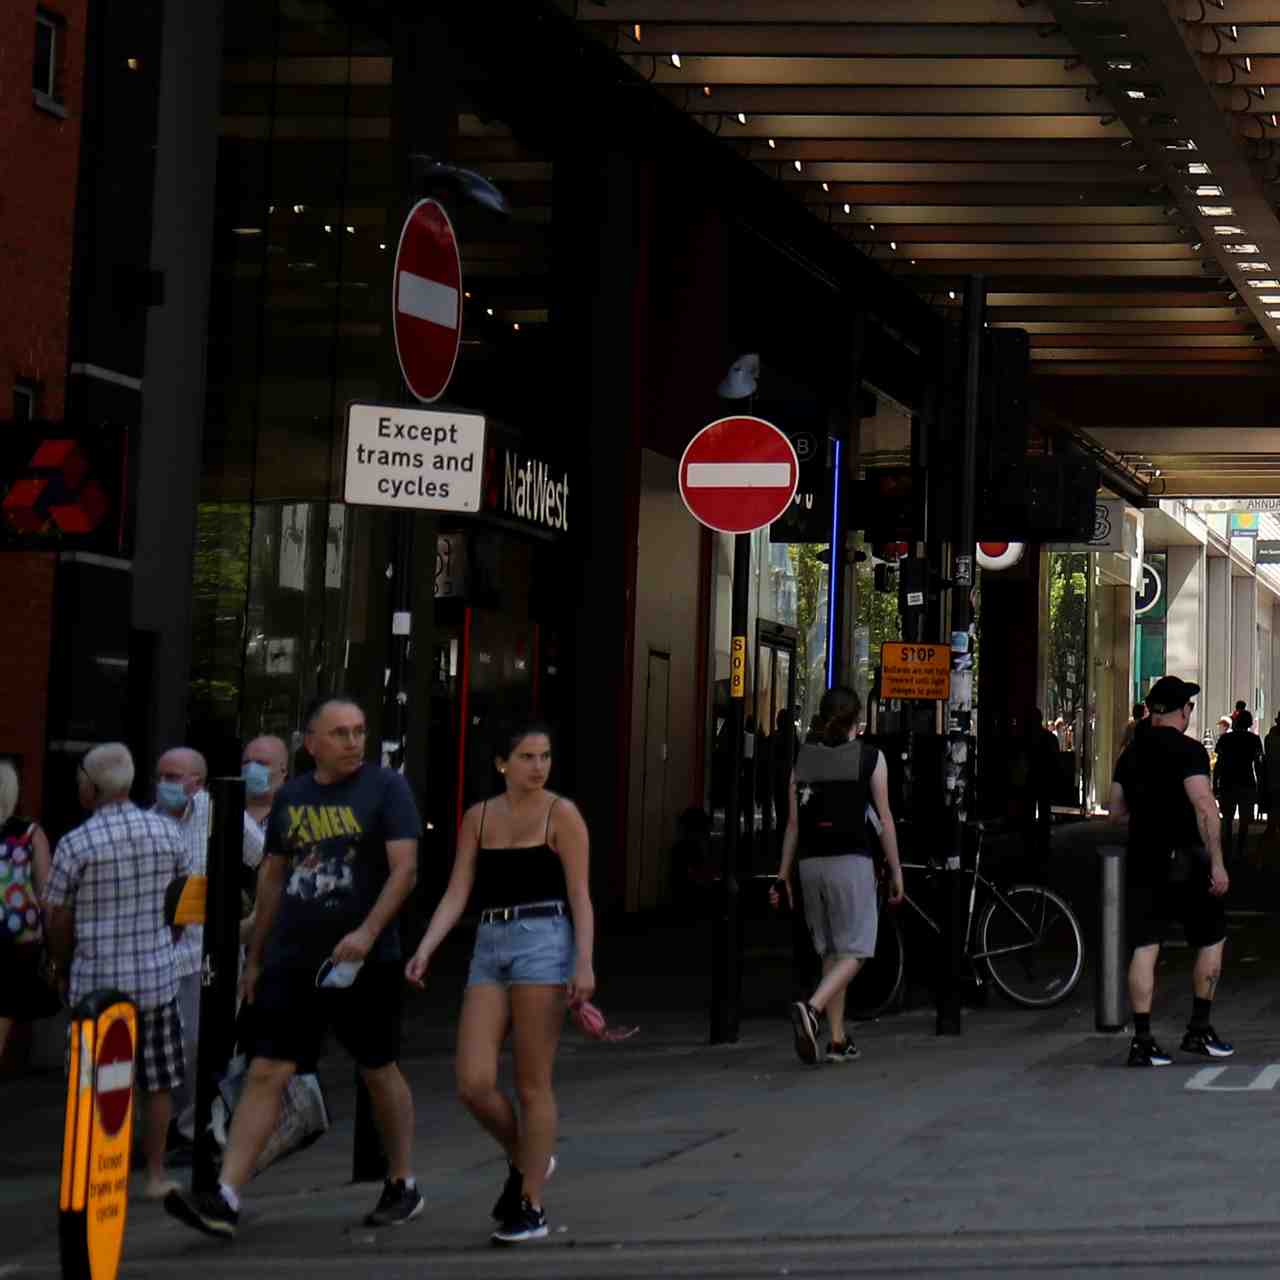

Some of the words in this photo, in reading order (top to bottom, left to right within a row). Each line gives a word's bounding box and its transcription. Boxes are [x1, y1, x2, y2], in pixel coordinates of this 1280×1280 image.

[378, 417, 458, 445] Except
[357, 444, 424, 469] trams
[432, 452, 474, 473] and
[377, 476, 450, 498] cycles
[504, 448, 569, 532] NatWest
[901, 647, 936, 662] STOP
[287, 805, 364, 844] X-MEN
